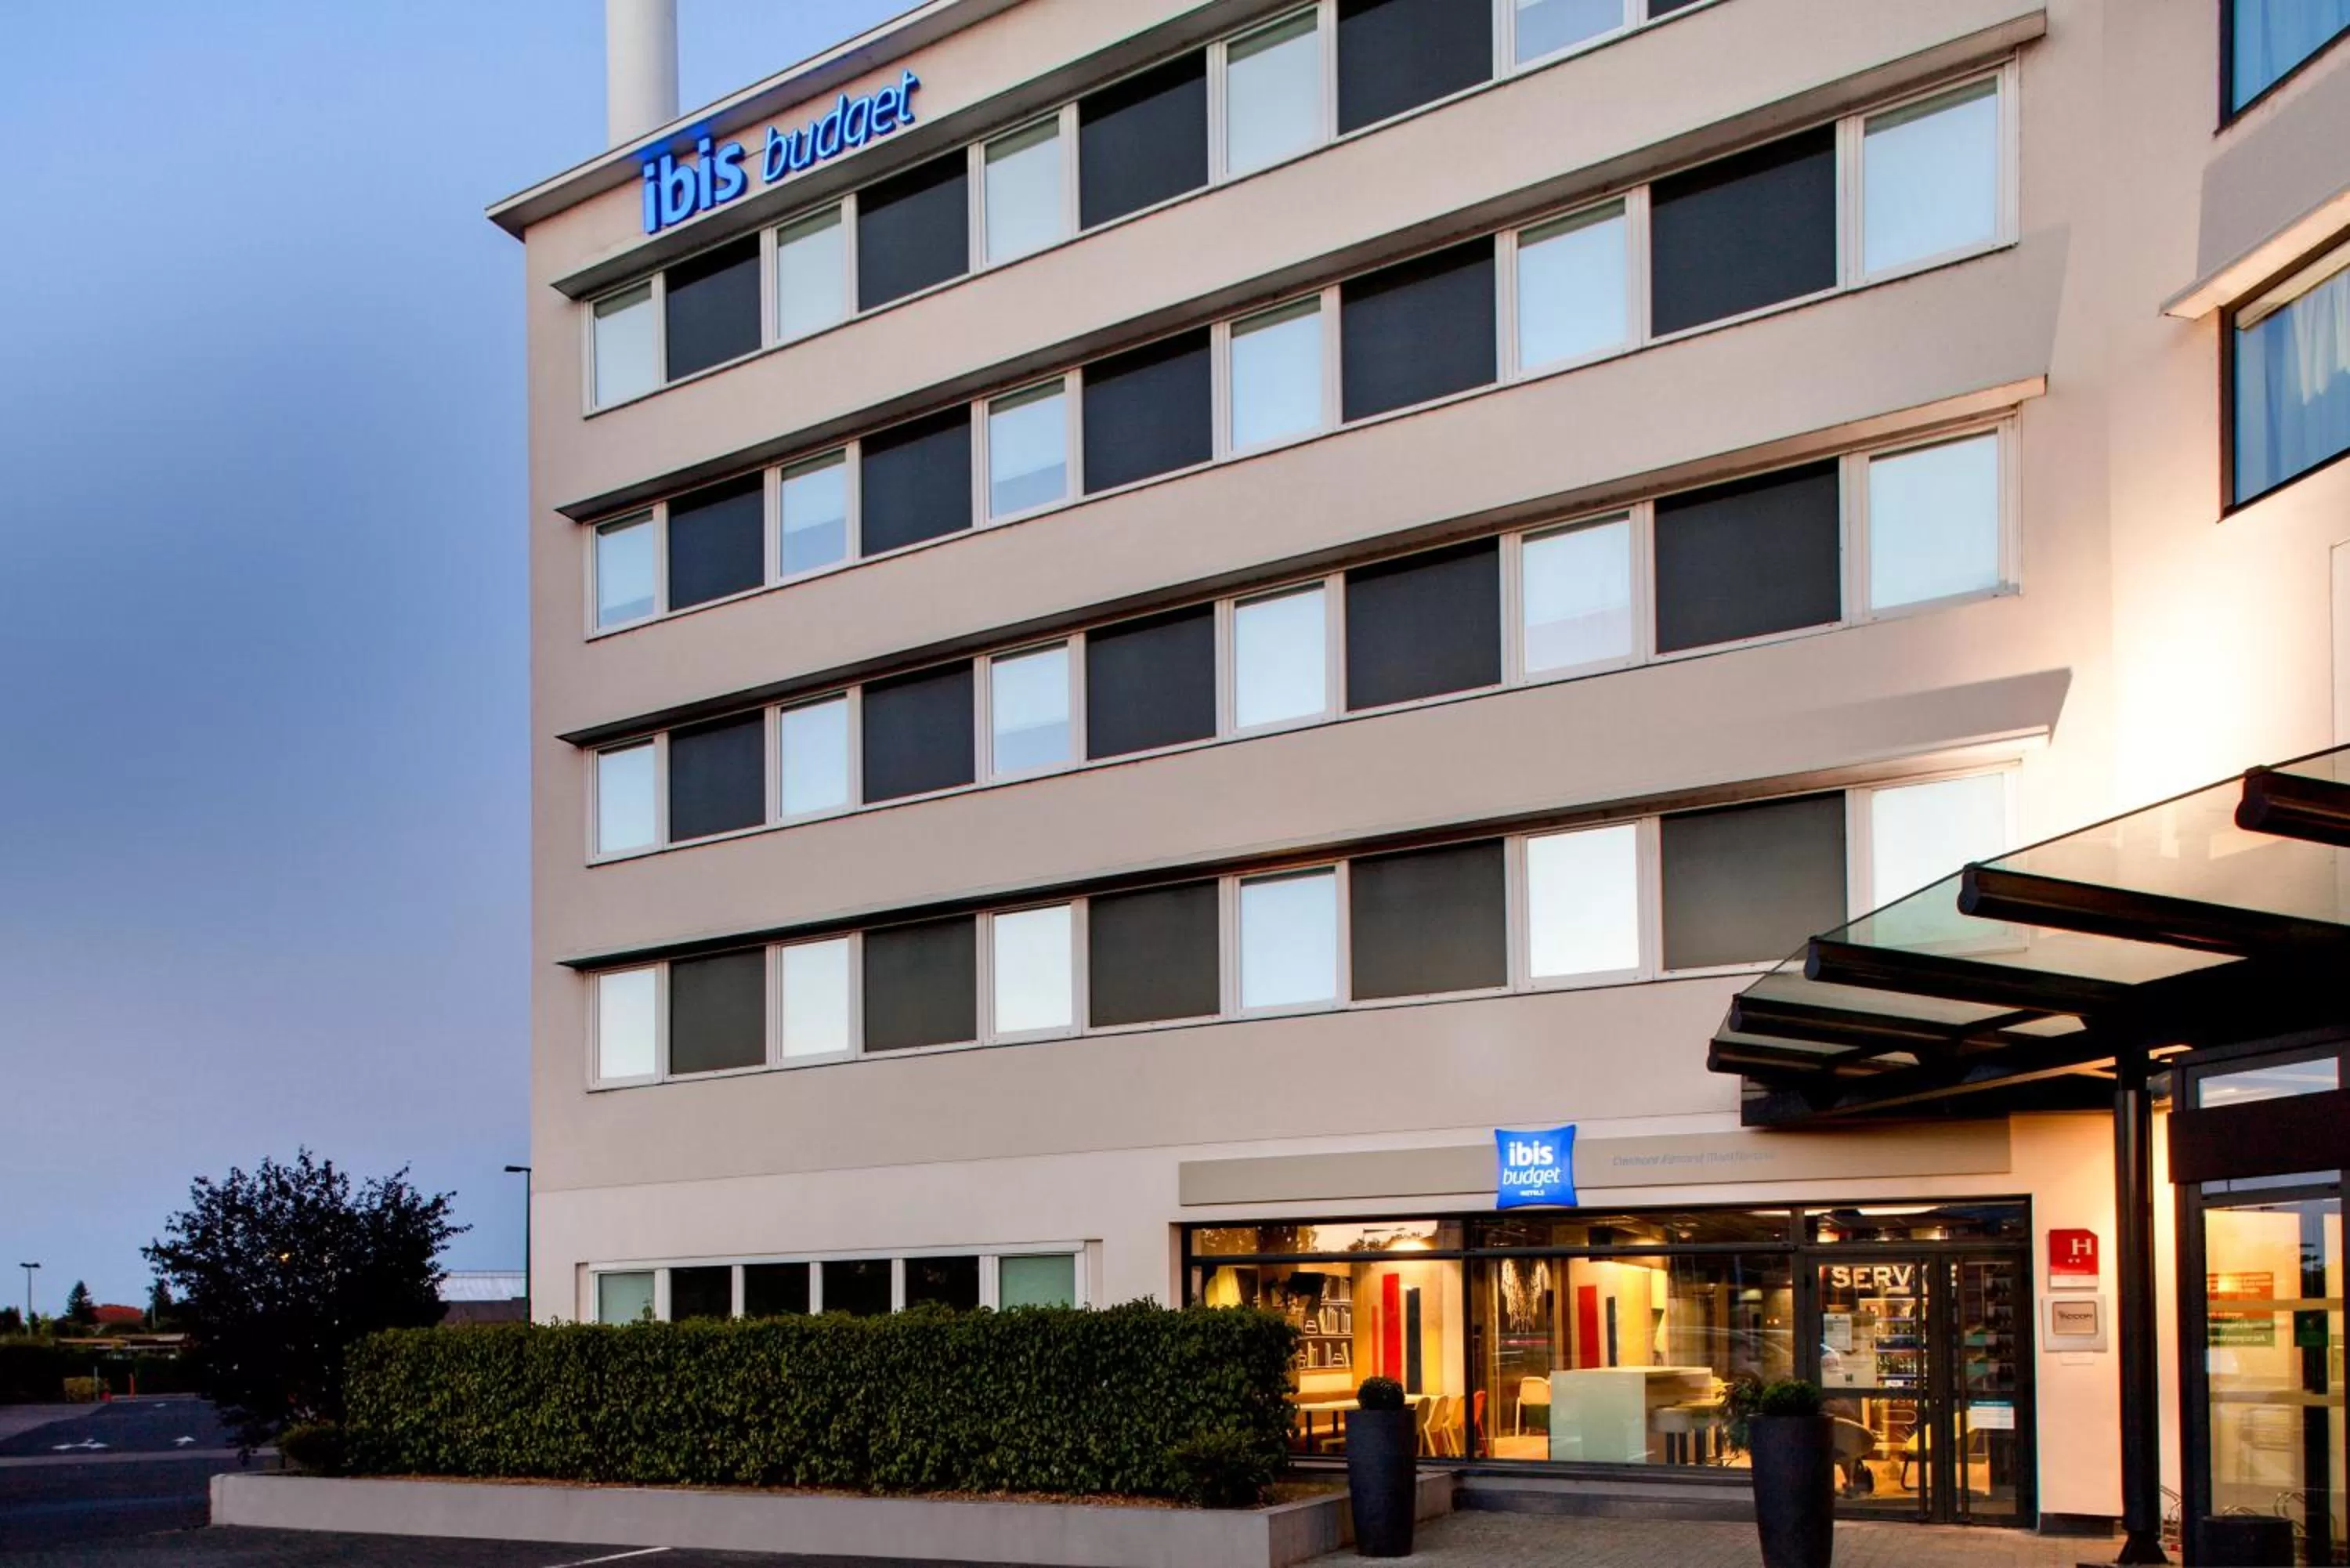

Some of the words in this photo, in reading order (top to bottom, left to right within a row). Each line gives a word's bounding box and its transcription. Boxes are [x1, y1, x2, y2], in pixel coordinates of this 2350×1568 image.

[643, 136, 747, 233] ibis
[761, 69, 920, 183] budget
[1509, 1140, 1554, 1165] ibis
[1502, 1165, 1561, 1188] budget
[2071, 1237, 2094, 1255] H
[1831, 1264, 1957, 1289] SERV
